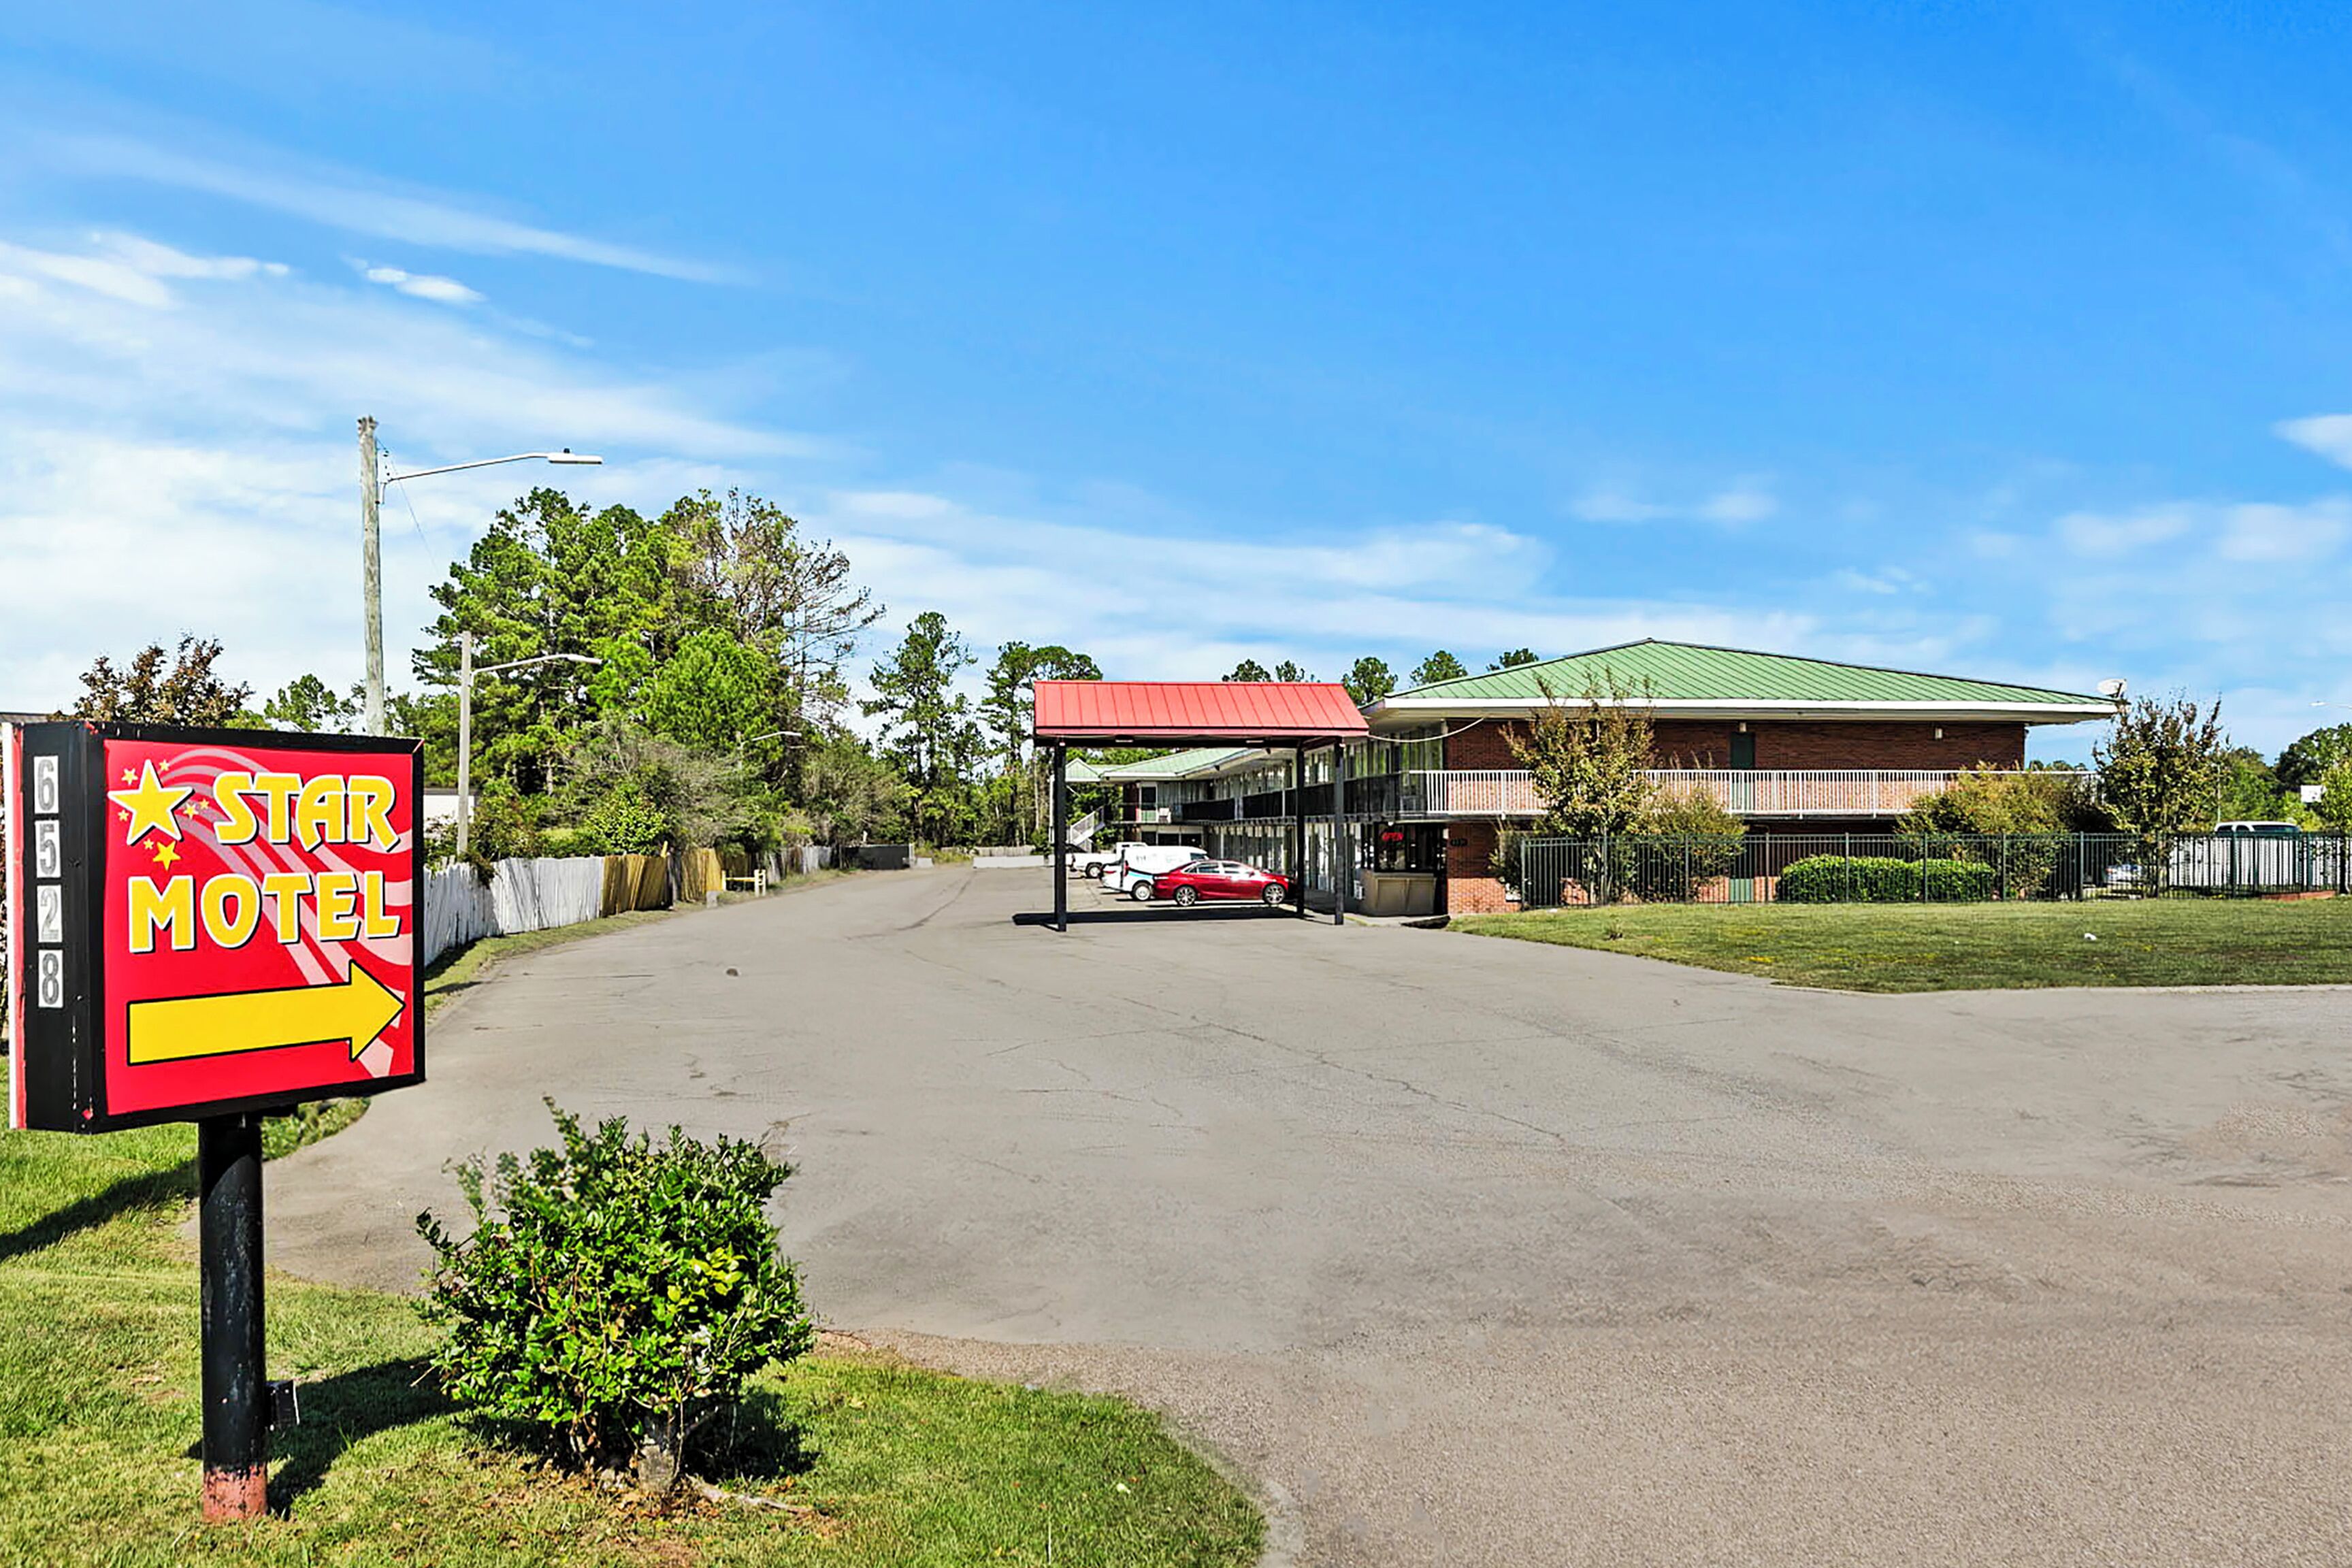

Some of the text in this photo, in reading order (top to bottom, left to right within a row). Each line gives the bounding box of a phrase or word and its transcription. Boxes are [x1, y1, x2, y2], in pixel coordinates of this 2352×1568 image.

[213, 771, 399, 851] STAR
[37, 759, 60, 1004] 6528
[128, 870, 401, 953] MOTEL
